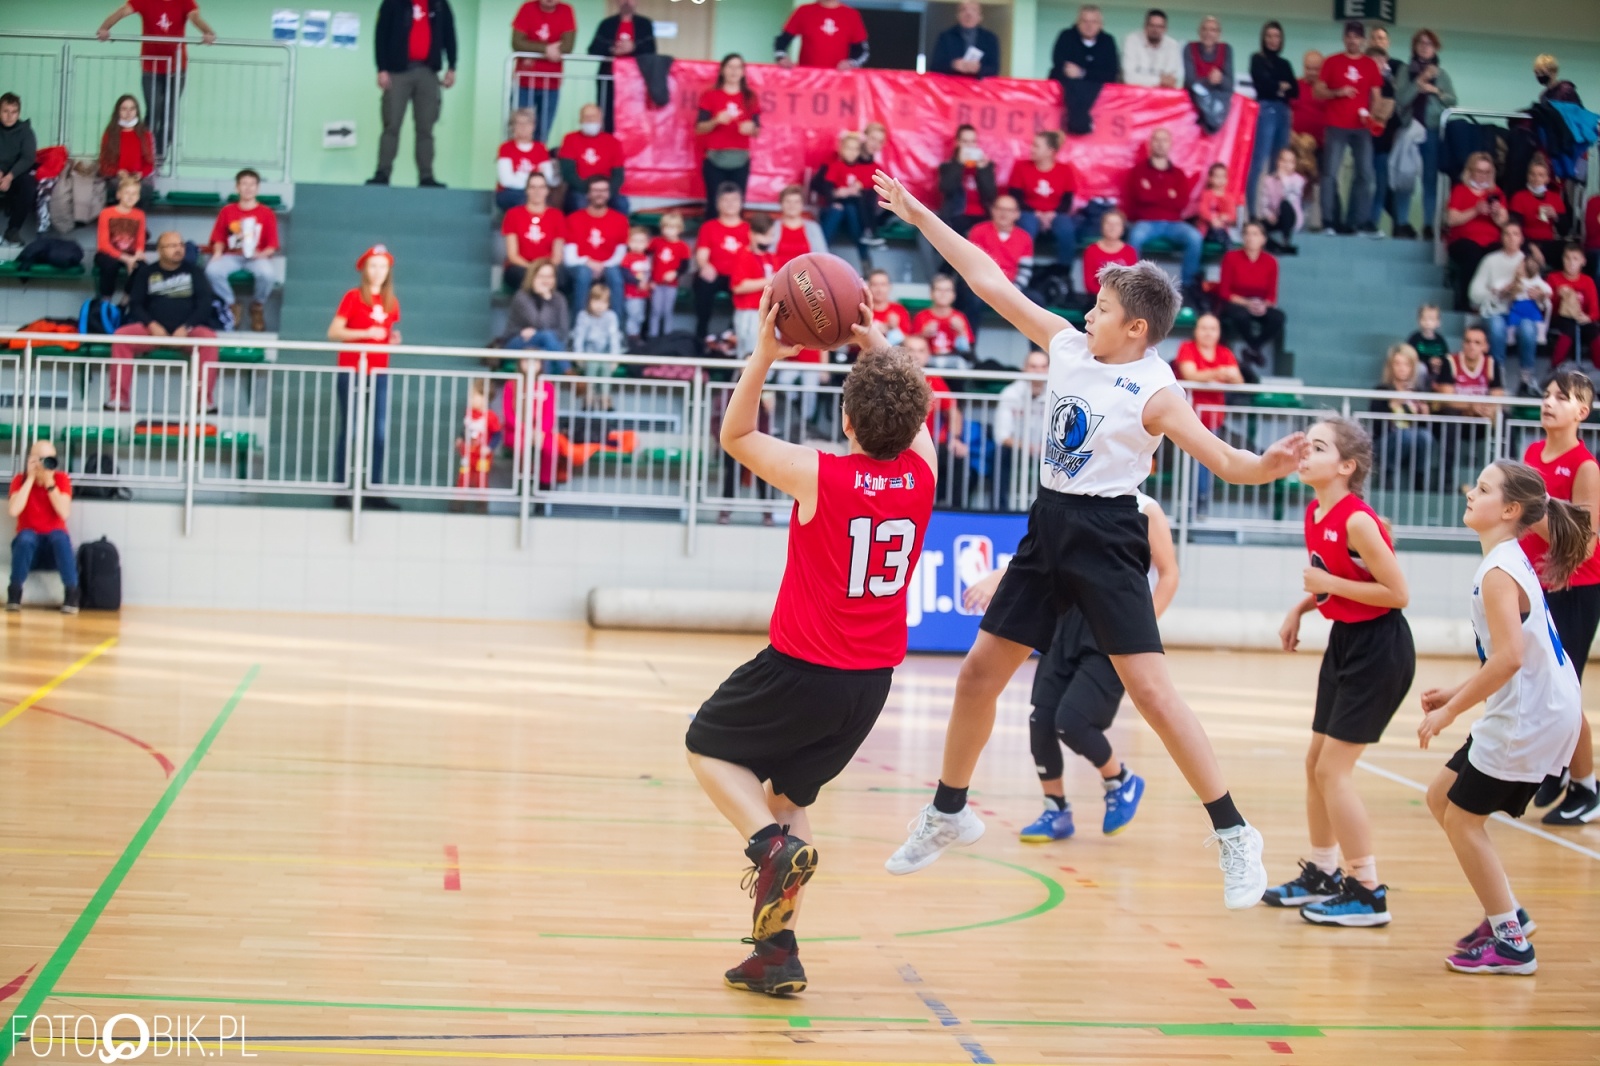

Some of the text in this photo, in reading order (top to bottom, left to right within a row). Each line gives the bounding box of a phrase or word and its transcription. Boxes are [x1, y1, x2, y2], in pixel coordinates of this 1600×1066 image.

[681, 89, 1127, 138] HSTON ROCKS
[793, 269, 832, 334] SPALDING
[847, 516, 917, 599] 13
